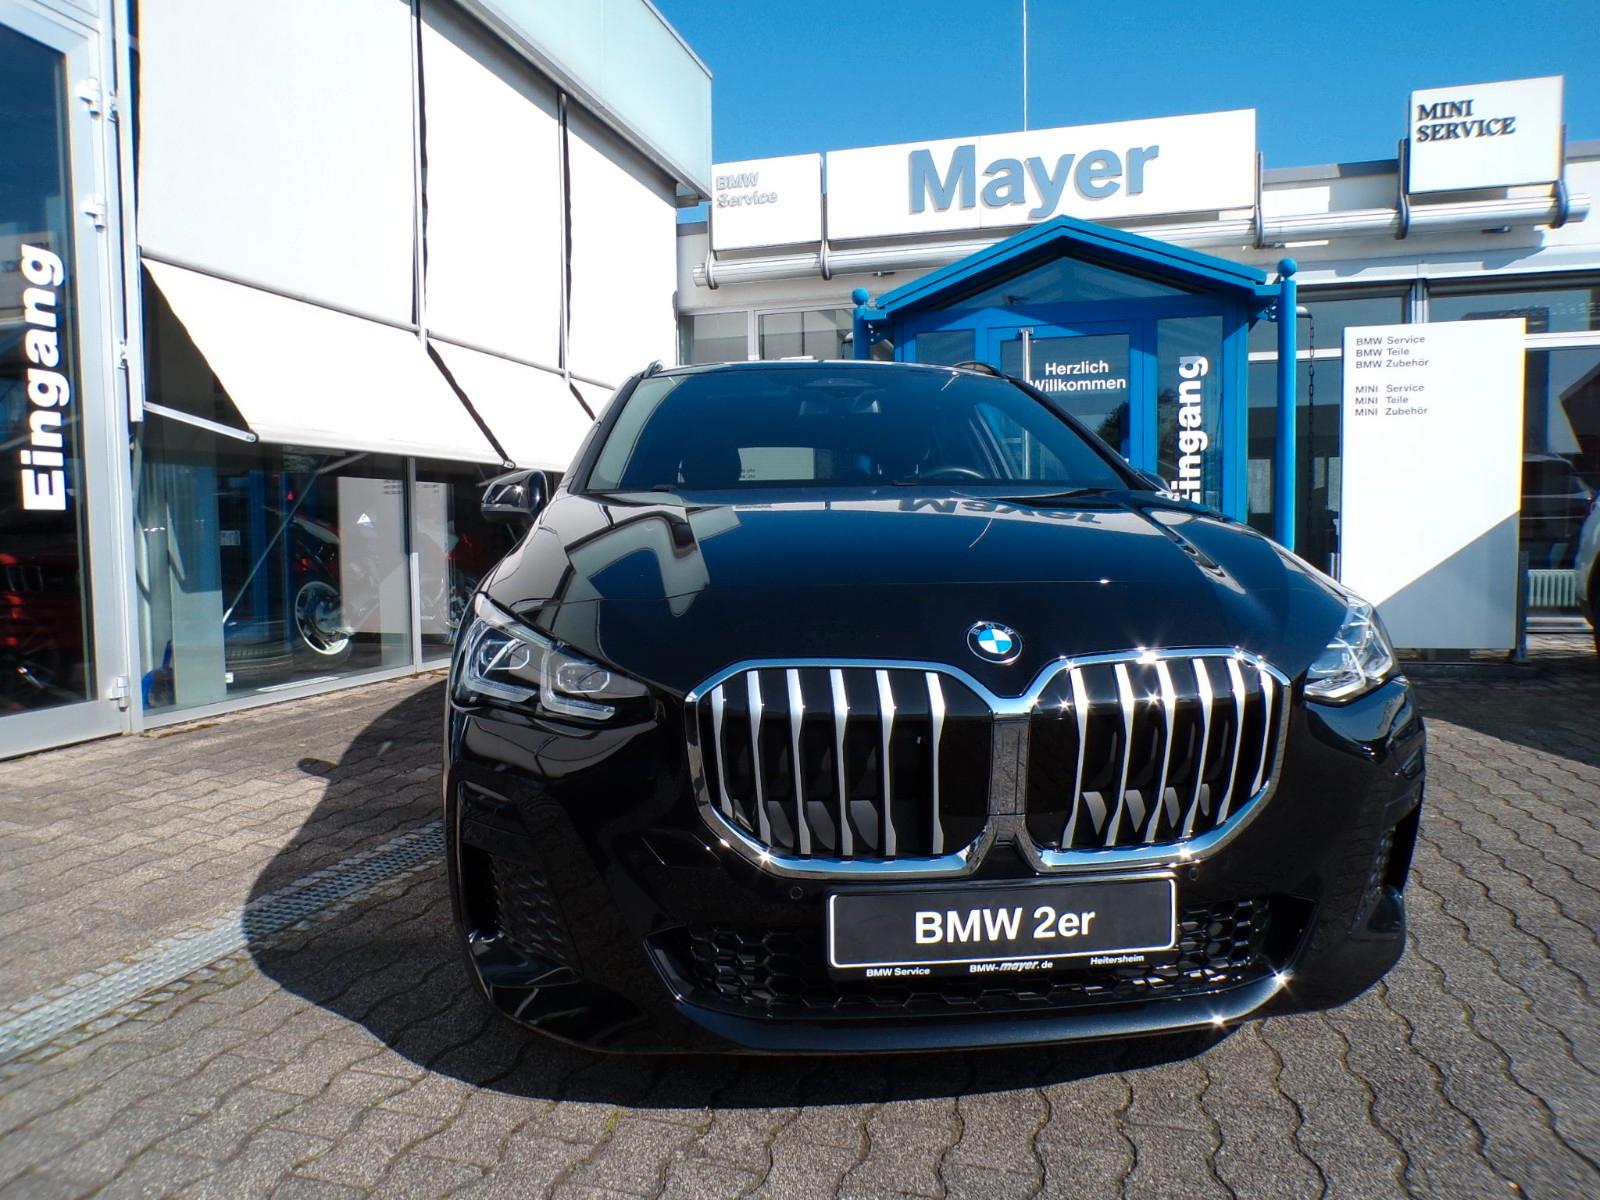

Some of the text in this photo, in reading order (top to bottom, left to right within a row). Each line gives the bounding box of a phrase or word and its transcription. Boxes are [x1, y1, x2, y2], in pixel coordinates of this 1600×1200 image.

[1417, 99, 1474, 122] MINI
[1417, 116, 1517, 143] SERVICE
[716, 172, 759, 191] BMW
[908, 144, 1160, 221] Mayer
[717, 190, 778, 208] Service
[1356, 335, 1426, 346] BMW Service
[1356, 347, 1410, 357] BMW Teile
[1045, 360, 1109, 376] Herzlich
[1355, 358, 1429, 369] BMW Zubehör
[20, 243, 70, 511] Eingang
[1029, 378, 1126, 392] Willkommen
[1355, 383, 1425, 393] MINI Service
[1355, 395, 1409, 405] MINI Teile
[1354, 406, 1429, 416] MINI Zubehör
[914, 905, 1096, 944] BMW 2er
[1090, 954, 1145, 966] Heitersheim
[866, 966, 930, 977] BMW Service
